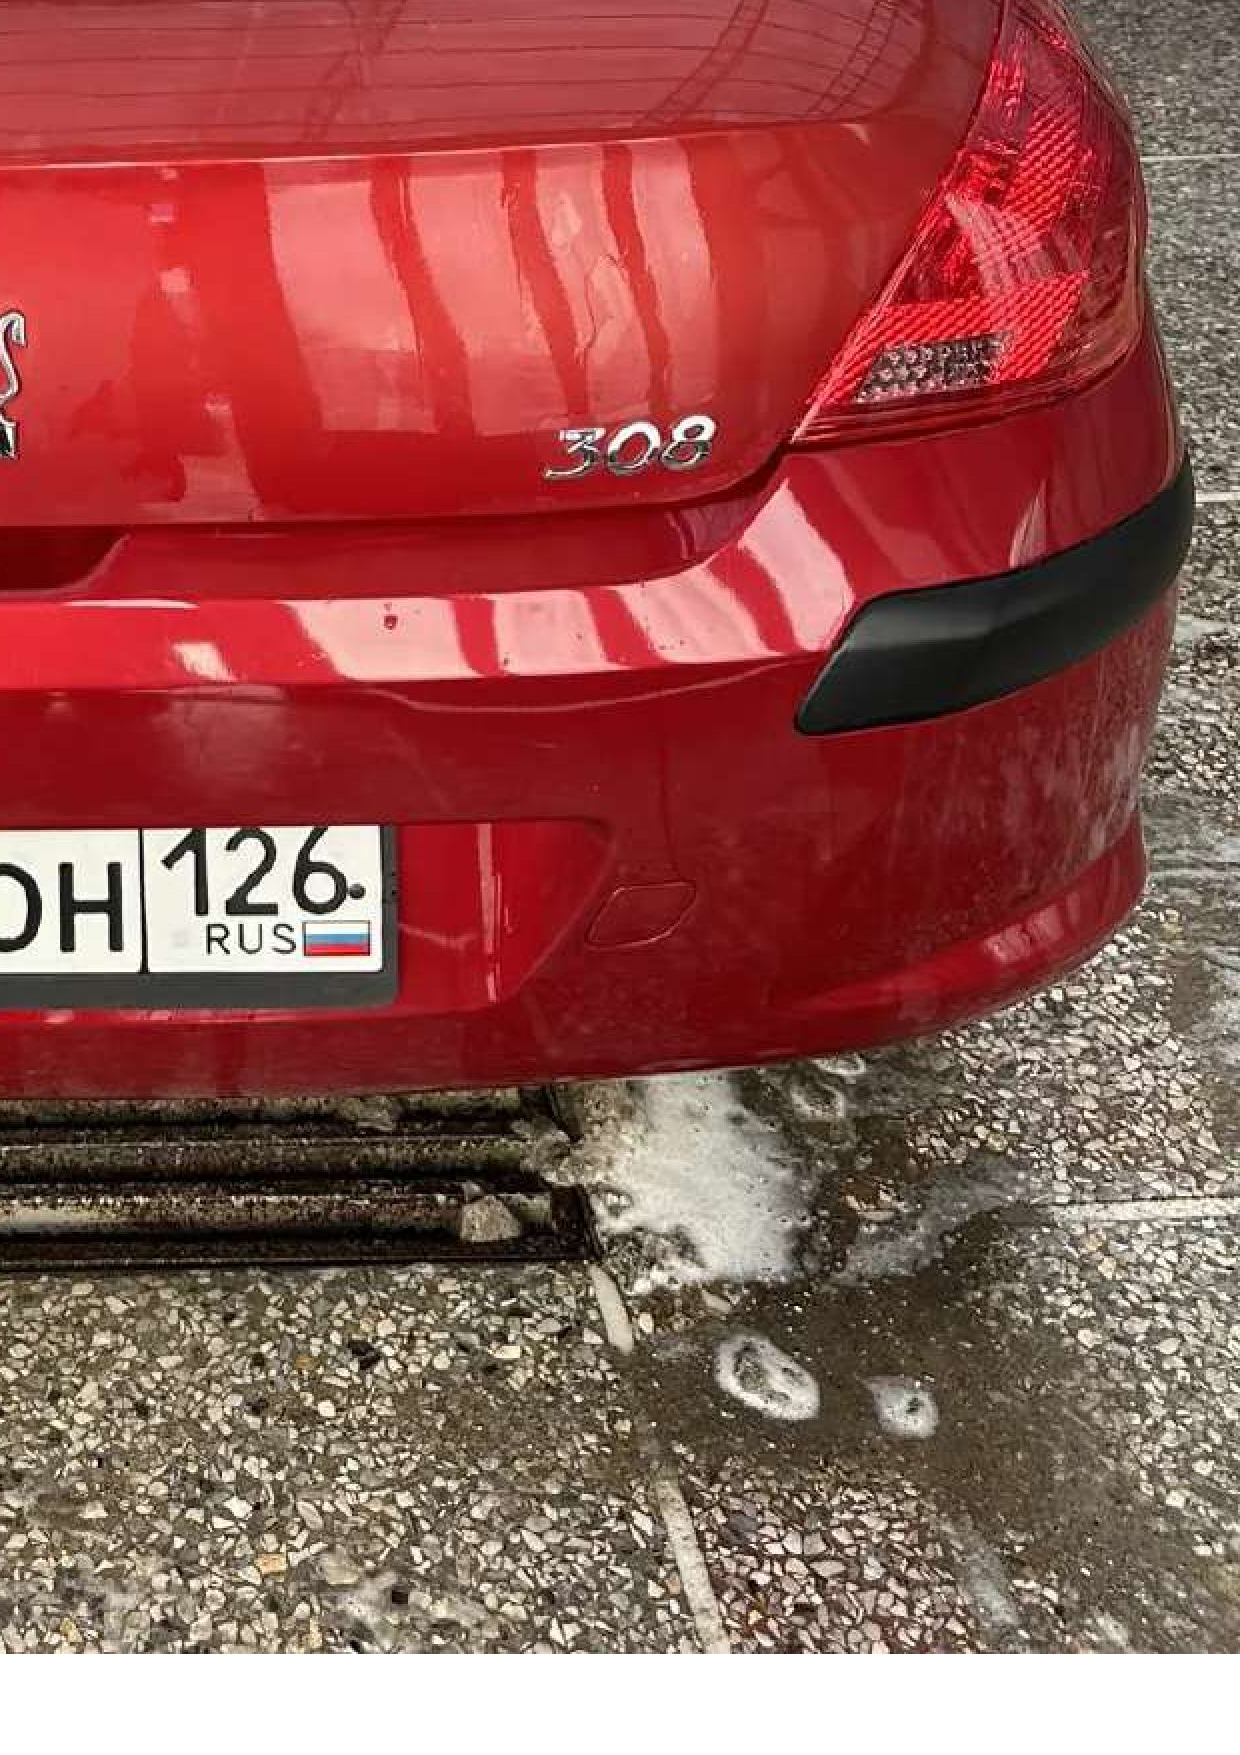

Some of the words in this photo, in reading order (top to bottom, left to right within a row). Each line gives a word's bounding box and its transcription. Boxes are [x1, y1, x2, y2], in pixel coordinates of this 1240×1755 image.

[543, 415, 717, 479] 308
[162, 826, 348, 916] 126
[206, 923, 297, 955] RUS
